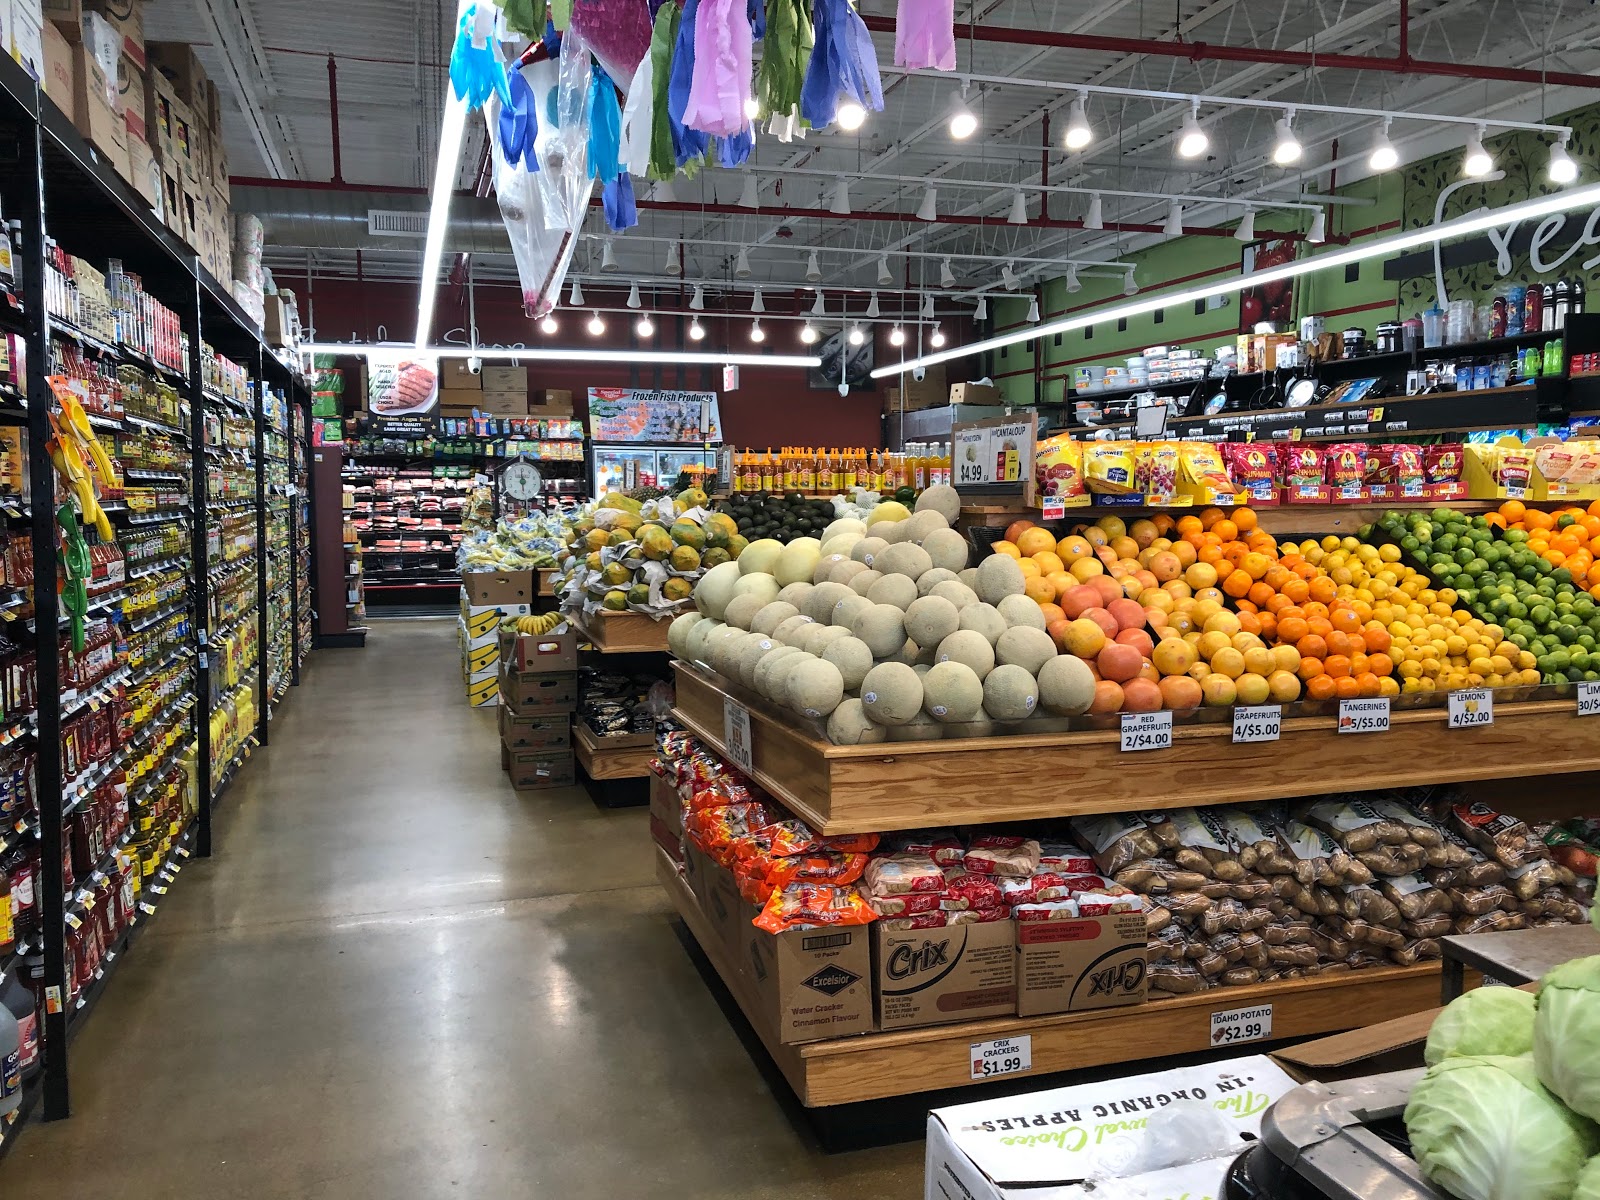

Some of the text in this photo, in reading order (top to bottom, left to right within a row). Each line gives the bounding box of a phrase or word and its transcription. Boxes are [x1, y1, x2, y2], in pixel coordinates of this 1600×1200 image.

[632, 392, 714, 402] Frozen Fish Products
[996, 426, 1026, 438] CANTALOUP
[961, 464, 982, 482] $4.99
[1457, 692, 1486, 702] LEMONS
[1344, 702, 1386, 712] TANGERINES
[1579, 698, 1600, 711] 30/$
[1235, 711, 1281, 720] GRAPEFRUITS
[1453, 712, 1490, 726] 4/$2.00
[1122, 722, 1172, 733] GRAPEFRUITS
[1351, 717, 1388, 729] 5/$5.00
[1234, 724, 1279, 738] 4/$5.00
[1126, 733, 1168, 748] 2/$4.00
[886, 939, 950, 980] Crix
[812, 974, 850, 987] Excelsior
[1087, 958, 1146, 998] Crix
[792, 1004, 844, 1015] Water Cracker
[1213, 1008, 1272, 1024] IDAHO POTATO
[792, 1014, 860, 1028] Cinnamon Flavour
[1224, 1024, 1262, 1042] $2.99
[993, 1039, 1010, 1048] CRIX
[984, 1045, 1020, 1057] CRACKERS
[982, 1058, 1020, 1077] $1.99
[1092, 1087, 1207, 1118] ORGANIC
[982, 1109, 1082, 1132] APPLES
[1000, 1091, 1270, 1152] The ural Choice
